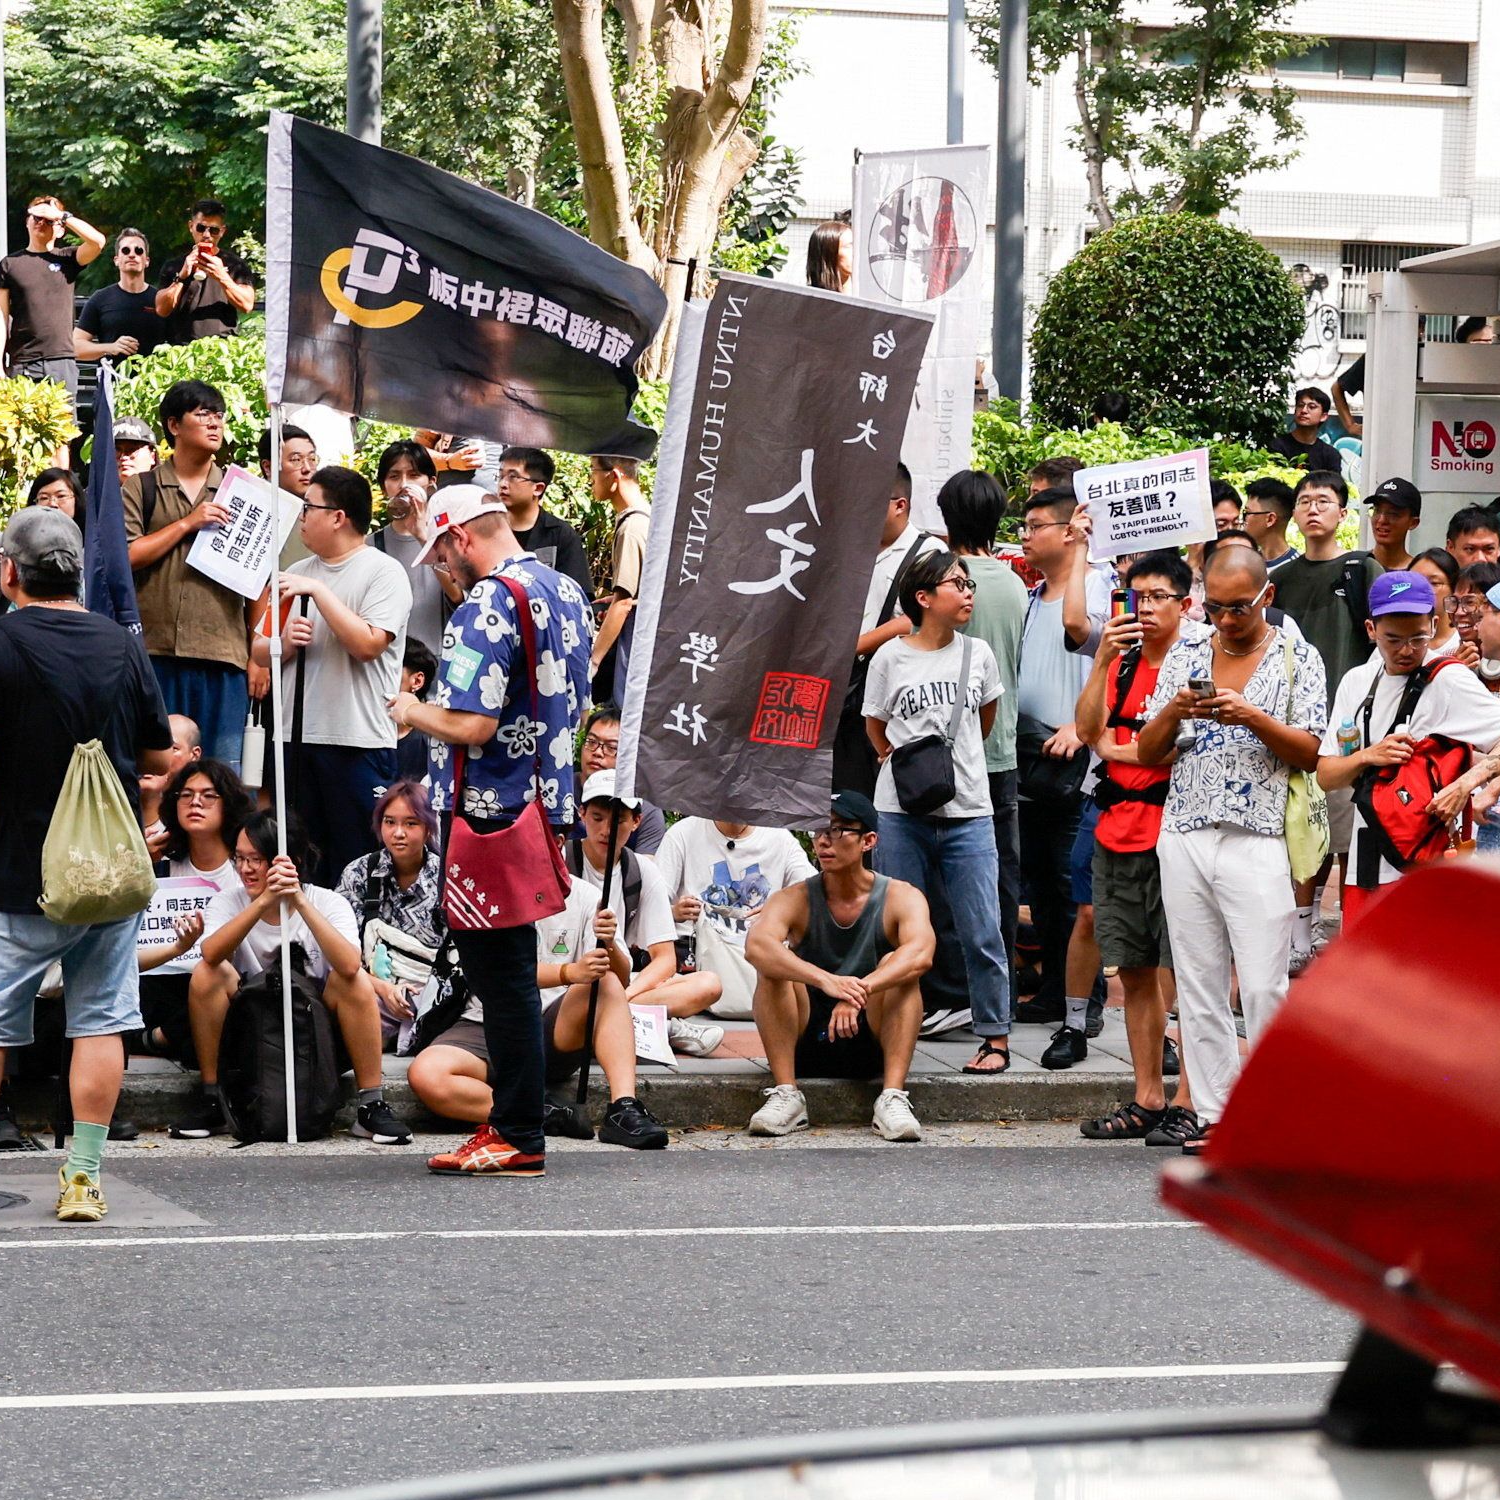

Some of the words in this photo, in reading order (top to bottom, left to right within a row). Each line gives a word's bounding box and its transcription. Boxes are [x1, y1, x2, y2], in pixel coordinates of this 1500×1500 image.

[1431, 420, 1496, 458] NO
[1431, 458, 1494, 475] Smoking
[1087, 467, 1197, 500] 台北真的同志
[1110, 530, 1142, 541] LGBTQ+
[1143, 521, 1190, 535] FRIENDLY?
[1112, 522, 1121, 531] IS
[1122, 518, 1149, 530] TAIPEI
[1150, 512, 1182, 524] REALLY
